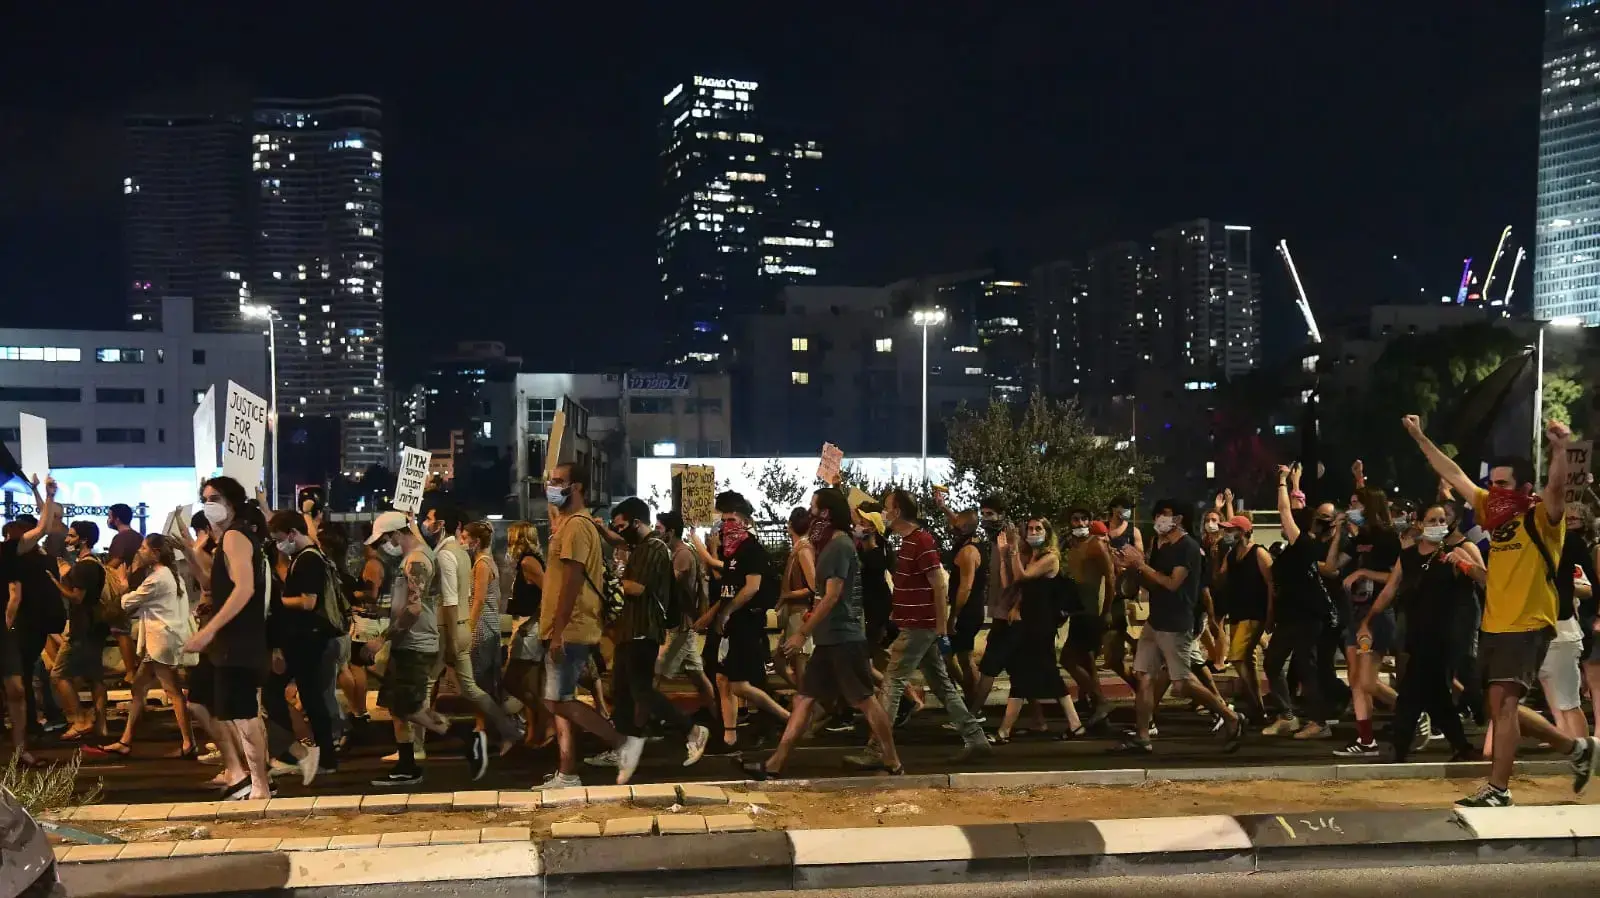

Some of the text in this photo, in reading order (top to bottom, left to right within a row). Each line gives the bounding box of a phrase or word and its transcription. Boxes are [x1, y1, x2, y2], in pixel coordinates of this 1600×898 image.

[230, 391, 265, 423] JUSTICE
[234, 416, 251, 439] FOR
[228, 433, 255, 461] EYAD
[406, 452, 427, 469] אדון
